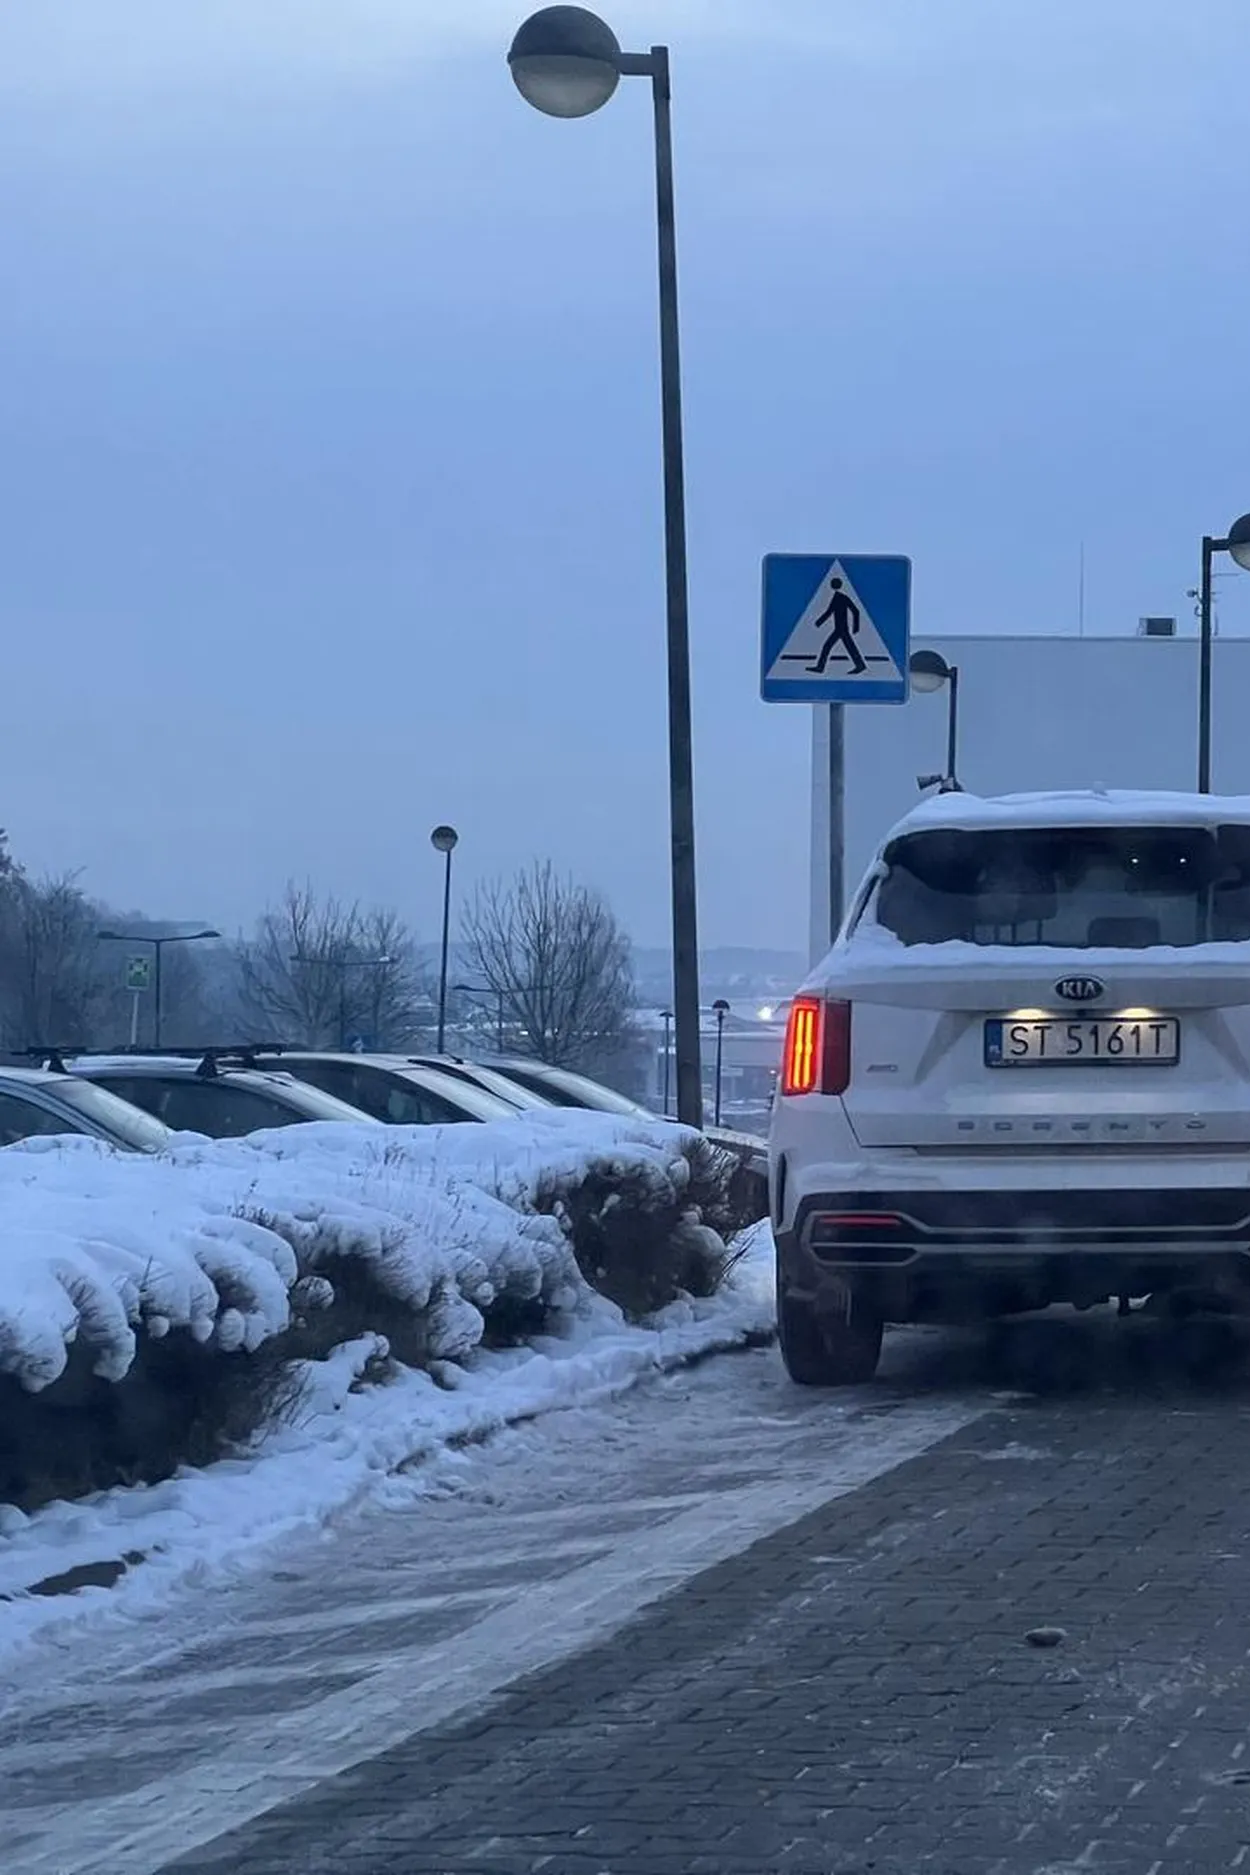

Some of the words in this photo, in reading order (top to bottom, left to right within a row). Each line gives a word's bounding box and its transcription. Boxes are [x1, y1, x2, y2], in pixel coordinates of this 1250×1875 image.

[1062, 981, 1097, 997] KIA
[1010, 1026, 1052, 1056] ST
[1066, 1025, 1168, 1056] 5161T
